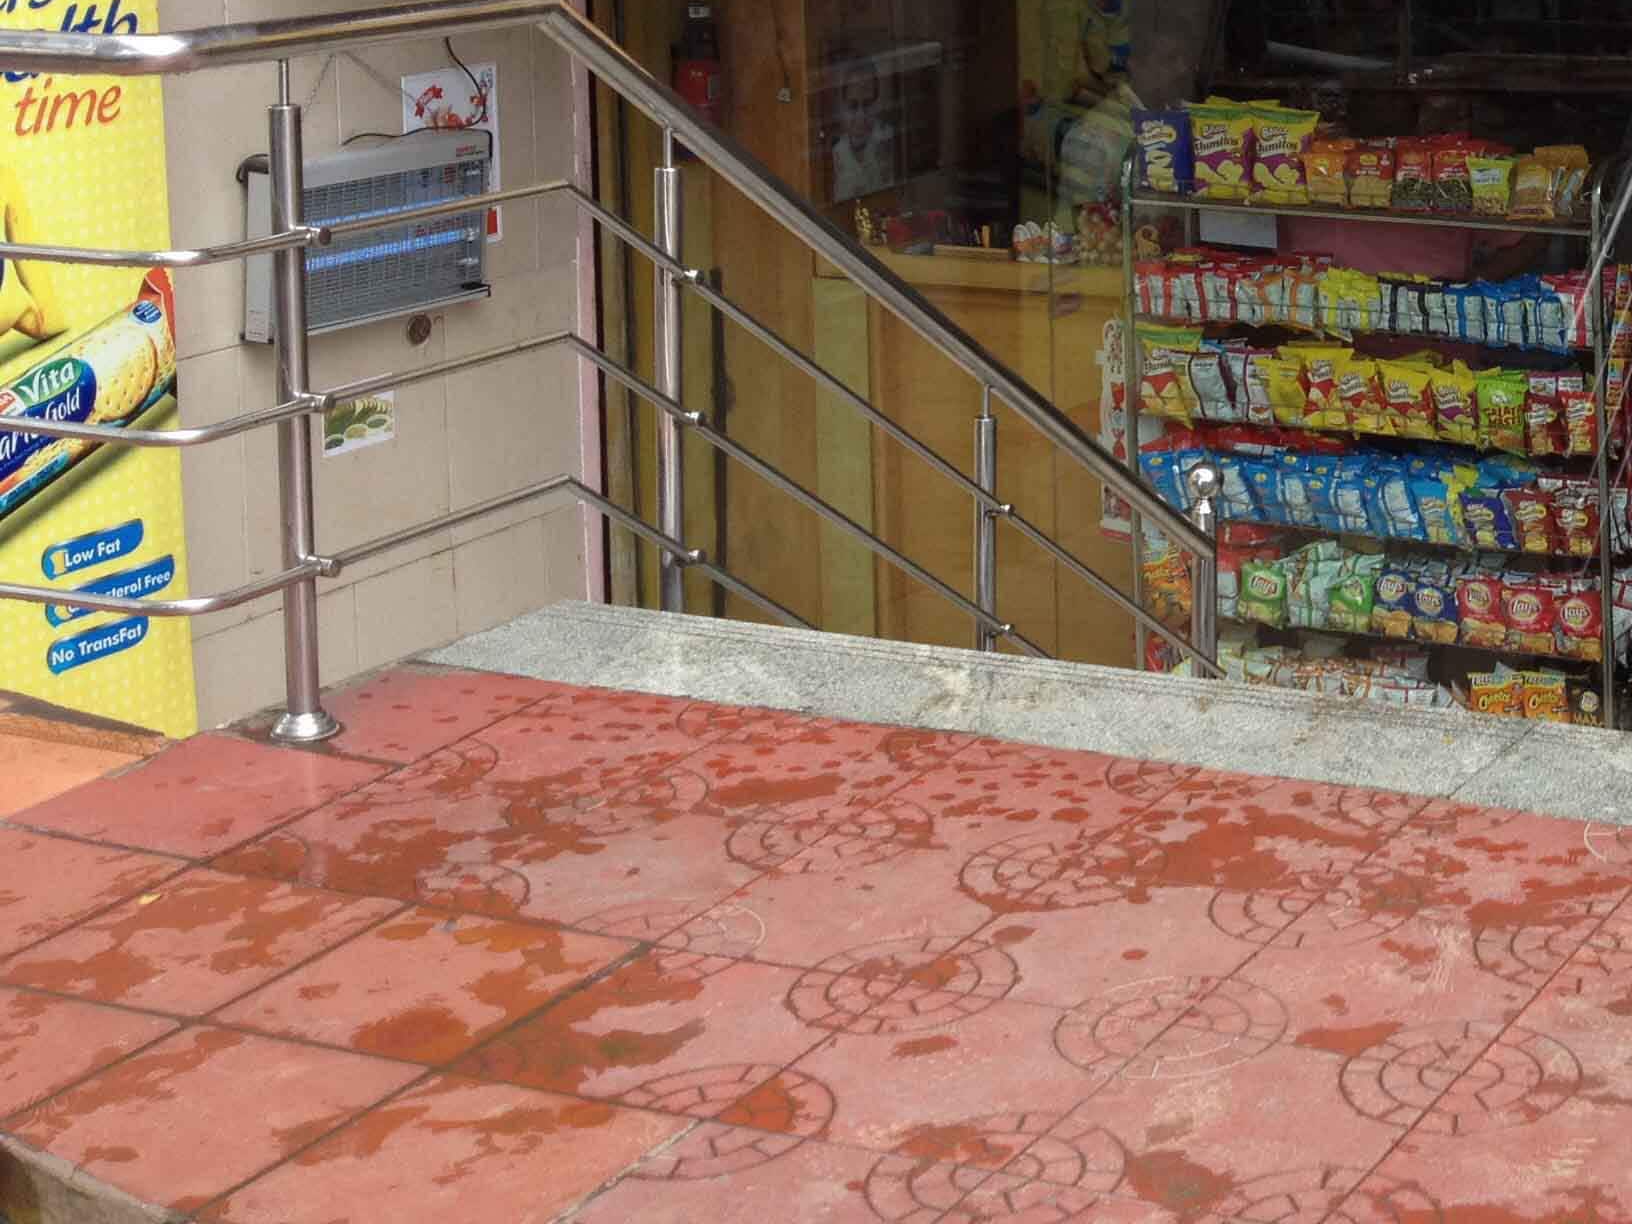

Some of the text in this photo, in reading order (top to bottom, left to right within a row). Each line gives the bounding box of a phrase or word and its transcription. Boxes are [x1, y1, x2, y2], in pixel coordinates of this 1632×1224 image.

[15, 77, 122, 136] time
[18, 360, 76, 403] Vita
[64, 539, 121, 567] Low Fat
[144, 571, 170, 588] Free
[52, 624, 142, 665] No TransFat
